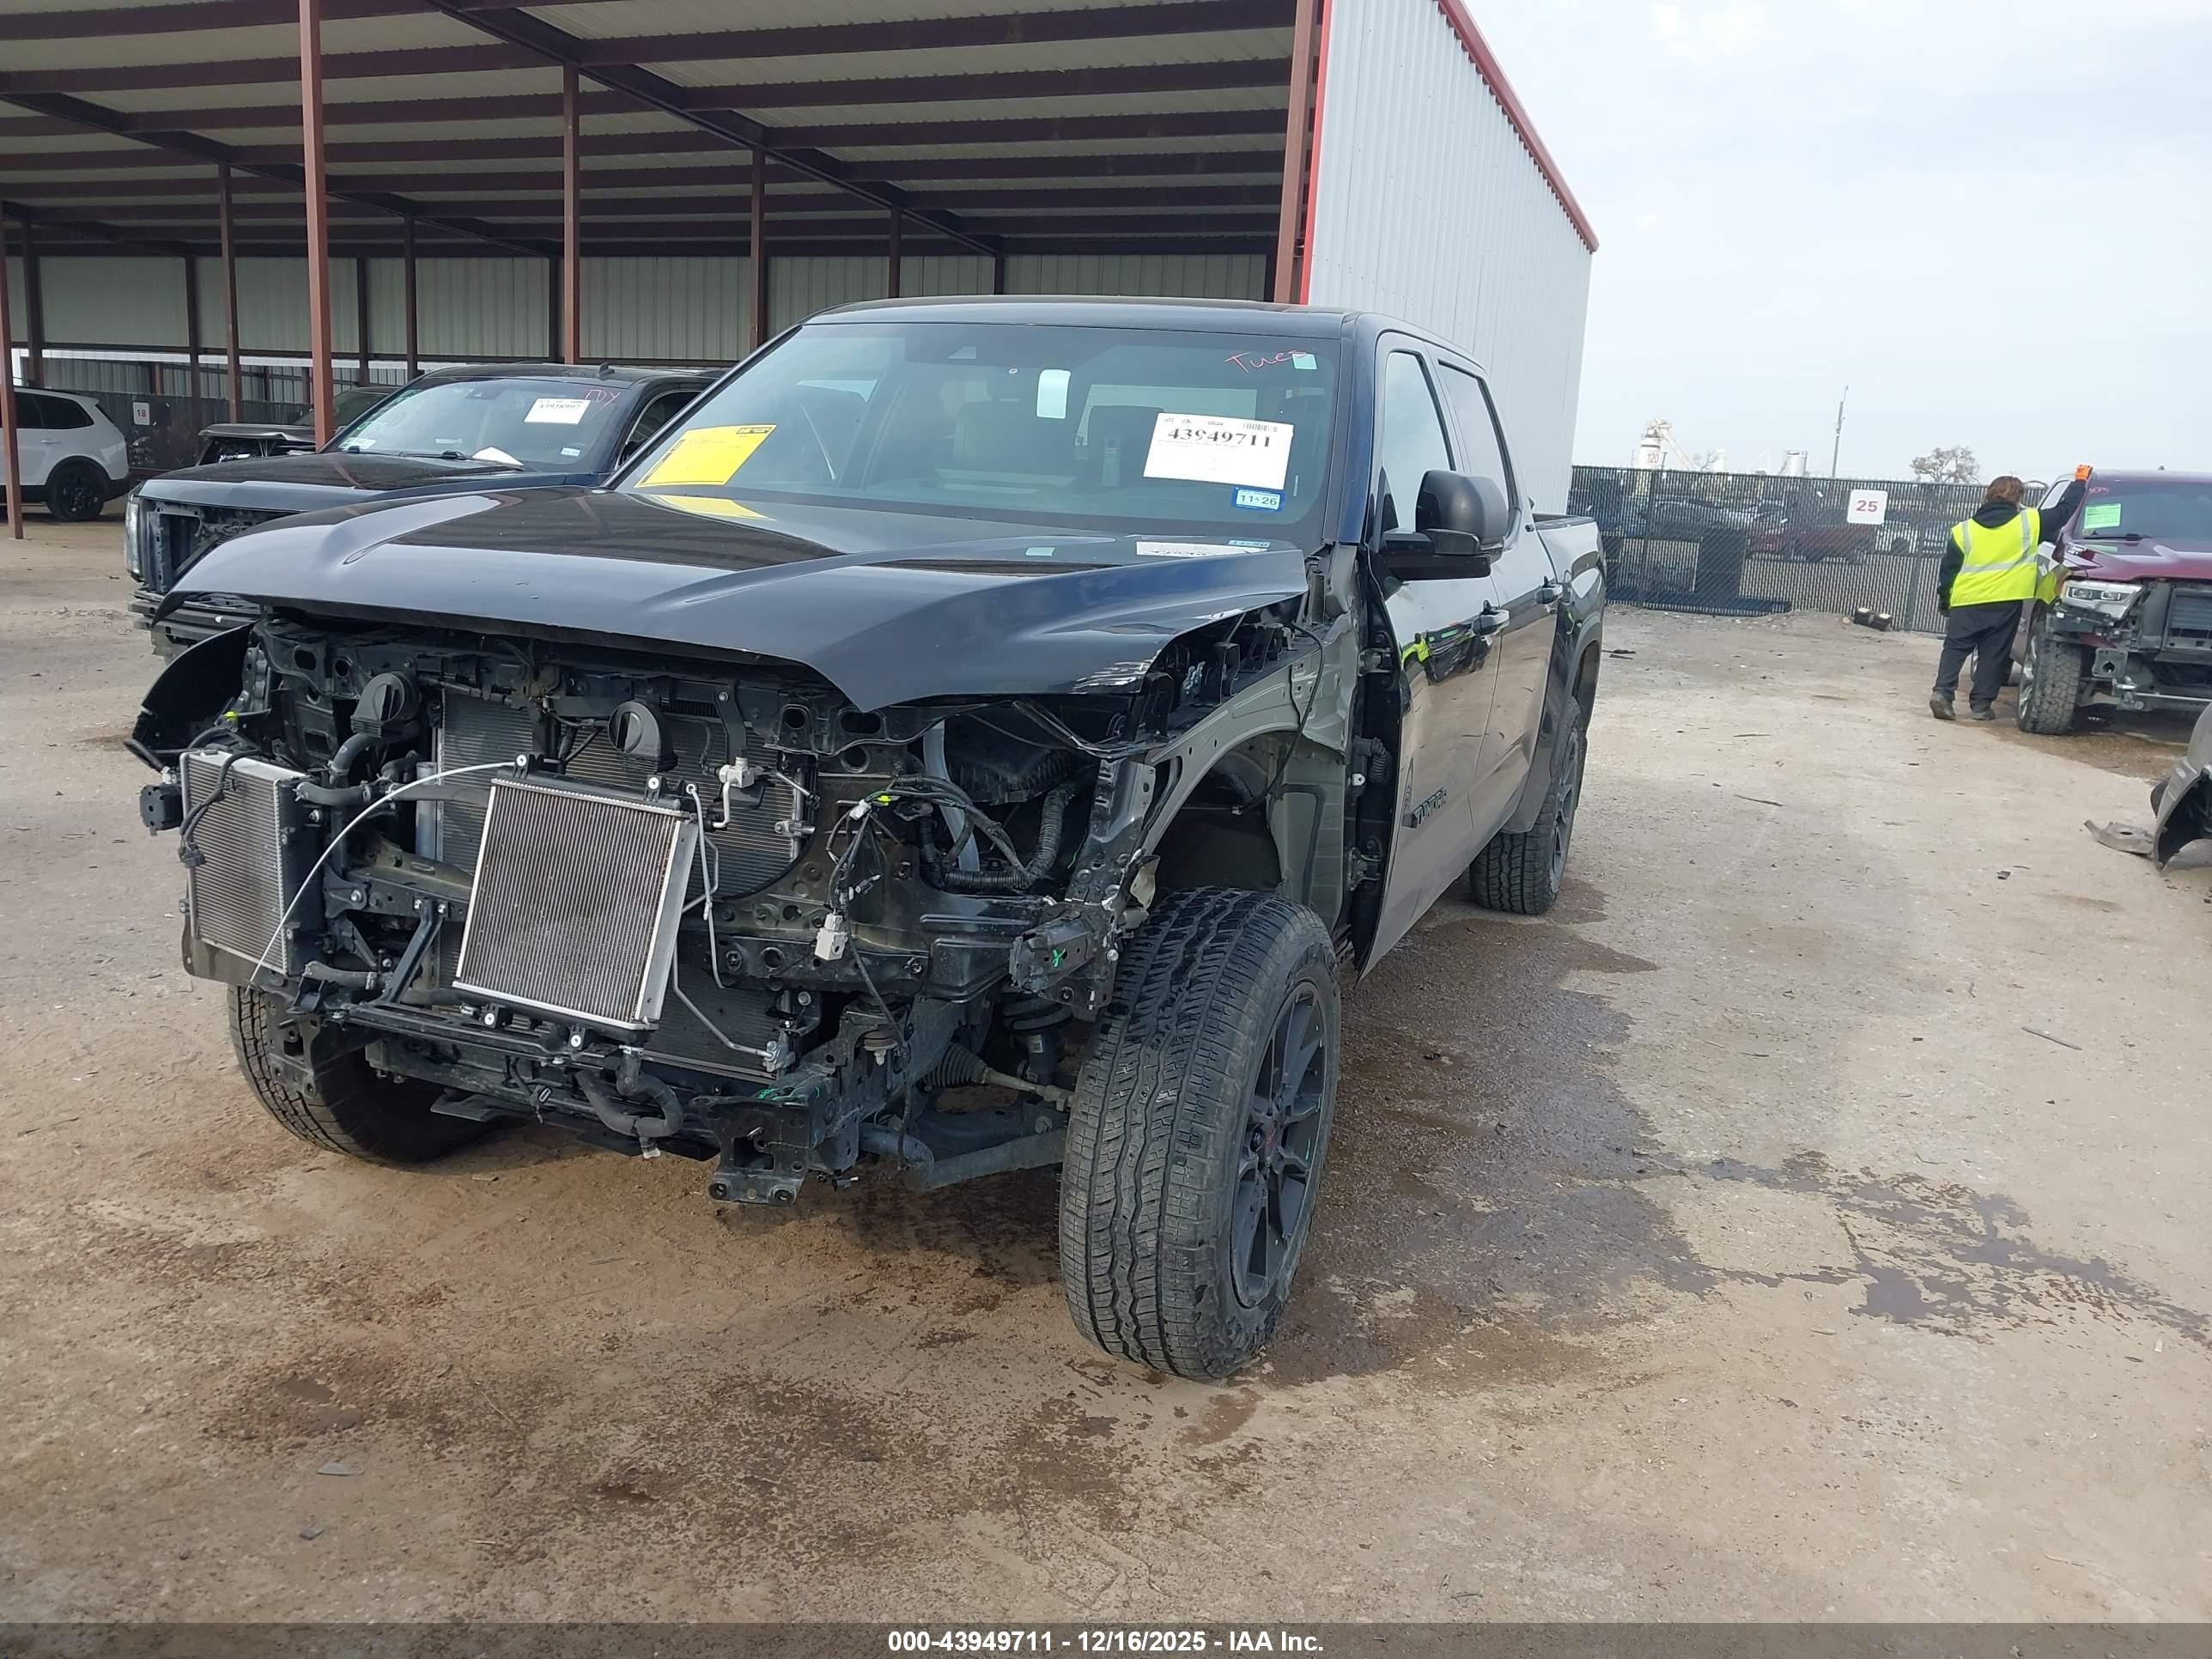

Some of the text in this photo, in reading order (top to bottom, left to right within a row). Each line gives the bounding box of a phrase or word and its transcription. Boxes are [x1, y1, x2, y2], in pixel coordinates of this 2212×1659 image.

[1168, 428, 1270, 447] 43949711
[1648, 453, 1660, 464] 120
[1856, 500, 1879, 513] 25
